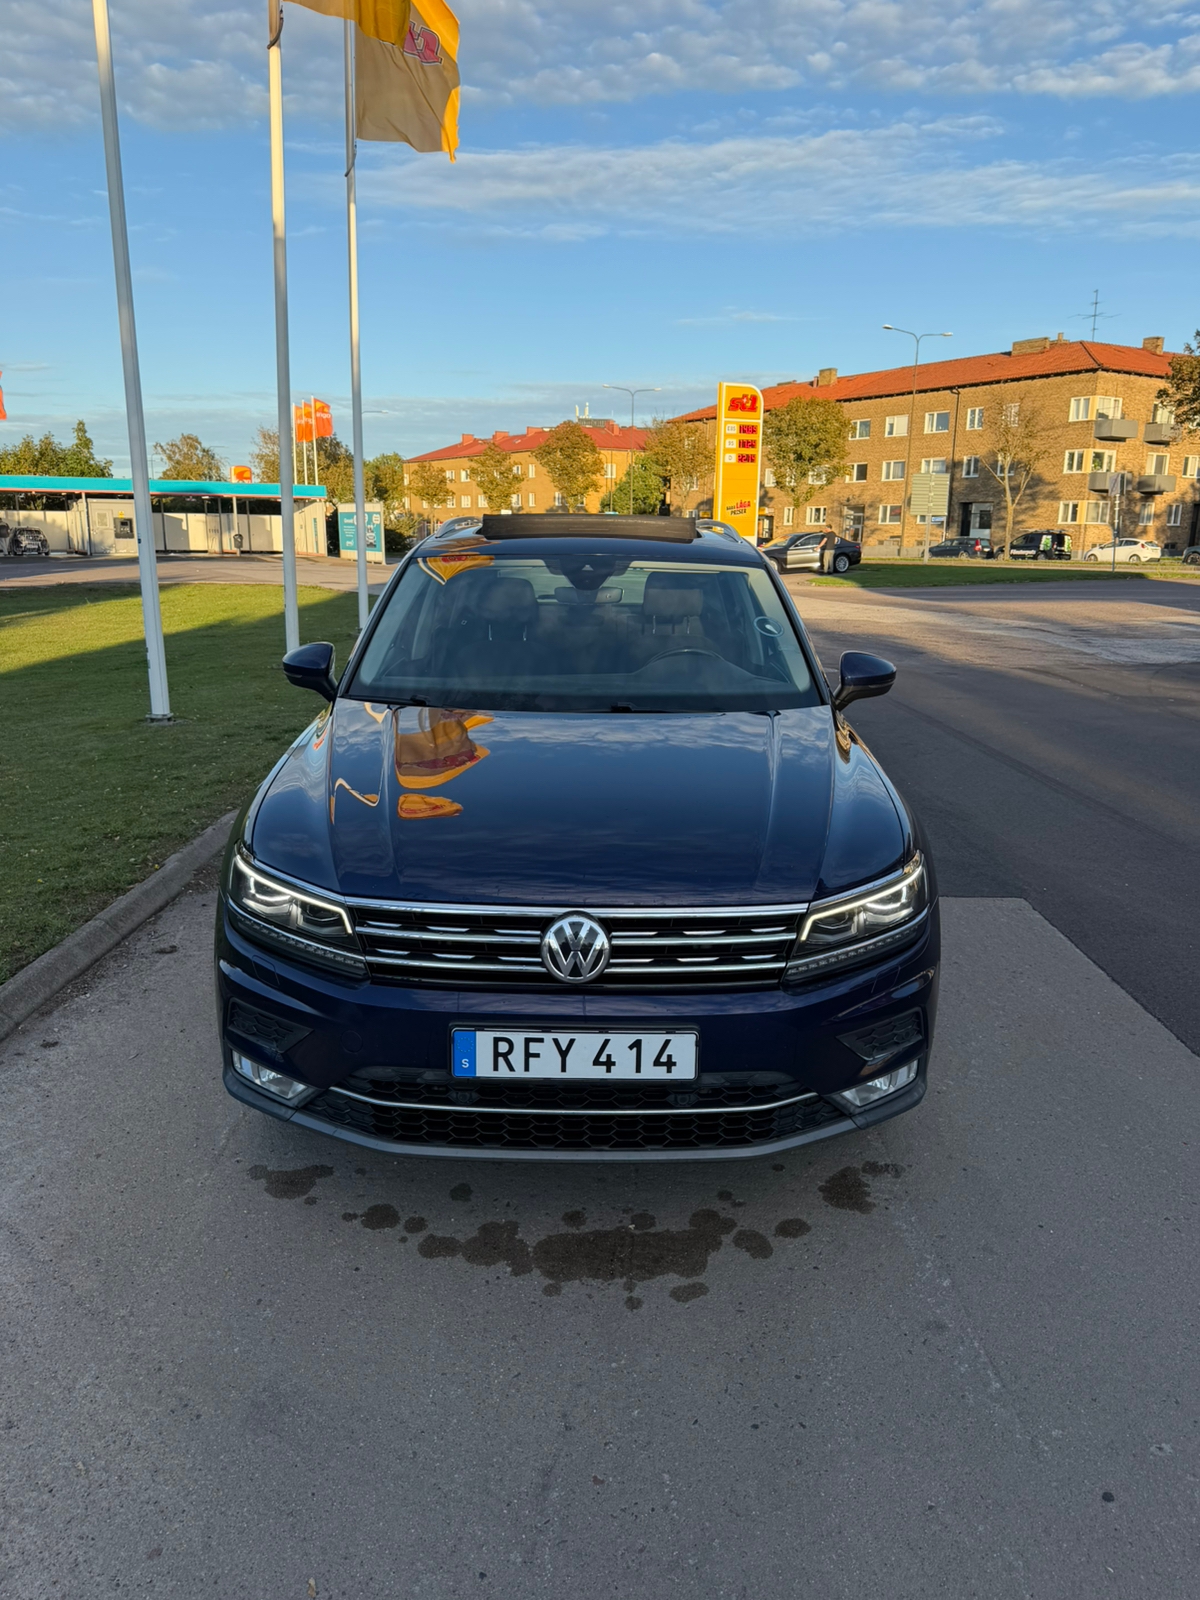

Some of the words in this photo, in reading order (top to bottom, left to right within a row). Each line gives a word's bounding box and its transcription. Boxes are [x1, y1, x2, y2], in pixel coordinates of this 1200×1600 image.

[728, 394, 758, 412] st1
[461, 1058, 469, 1068] S
[492, 1036, 576, 1073] RFY
[592, 1038, 677, 1074] 414
